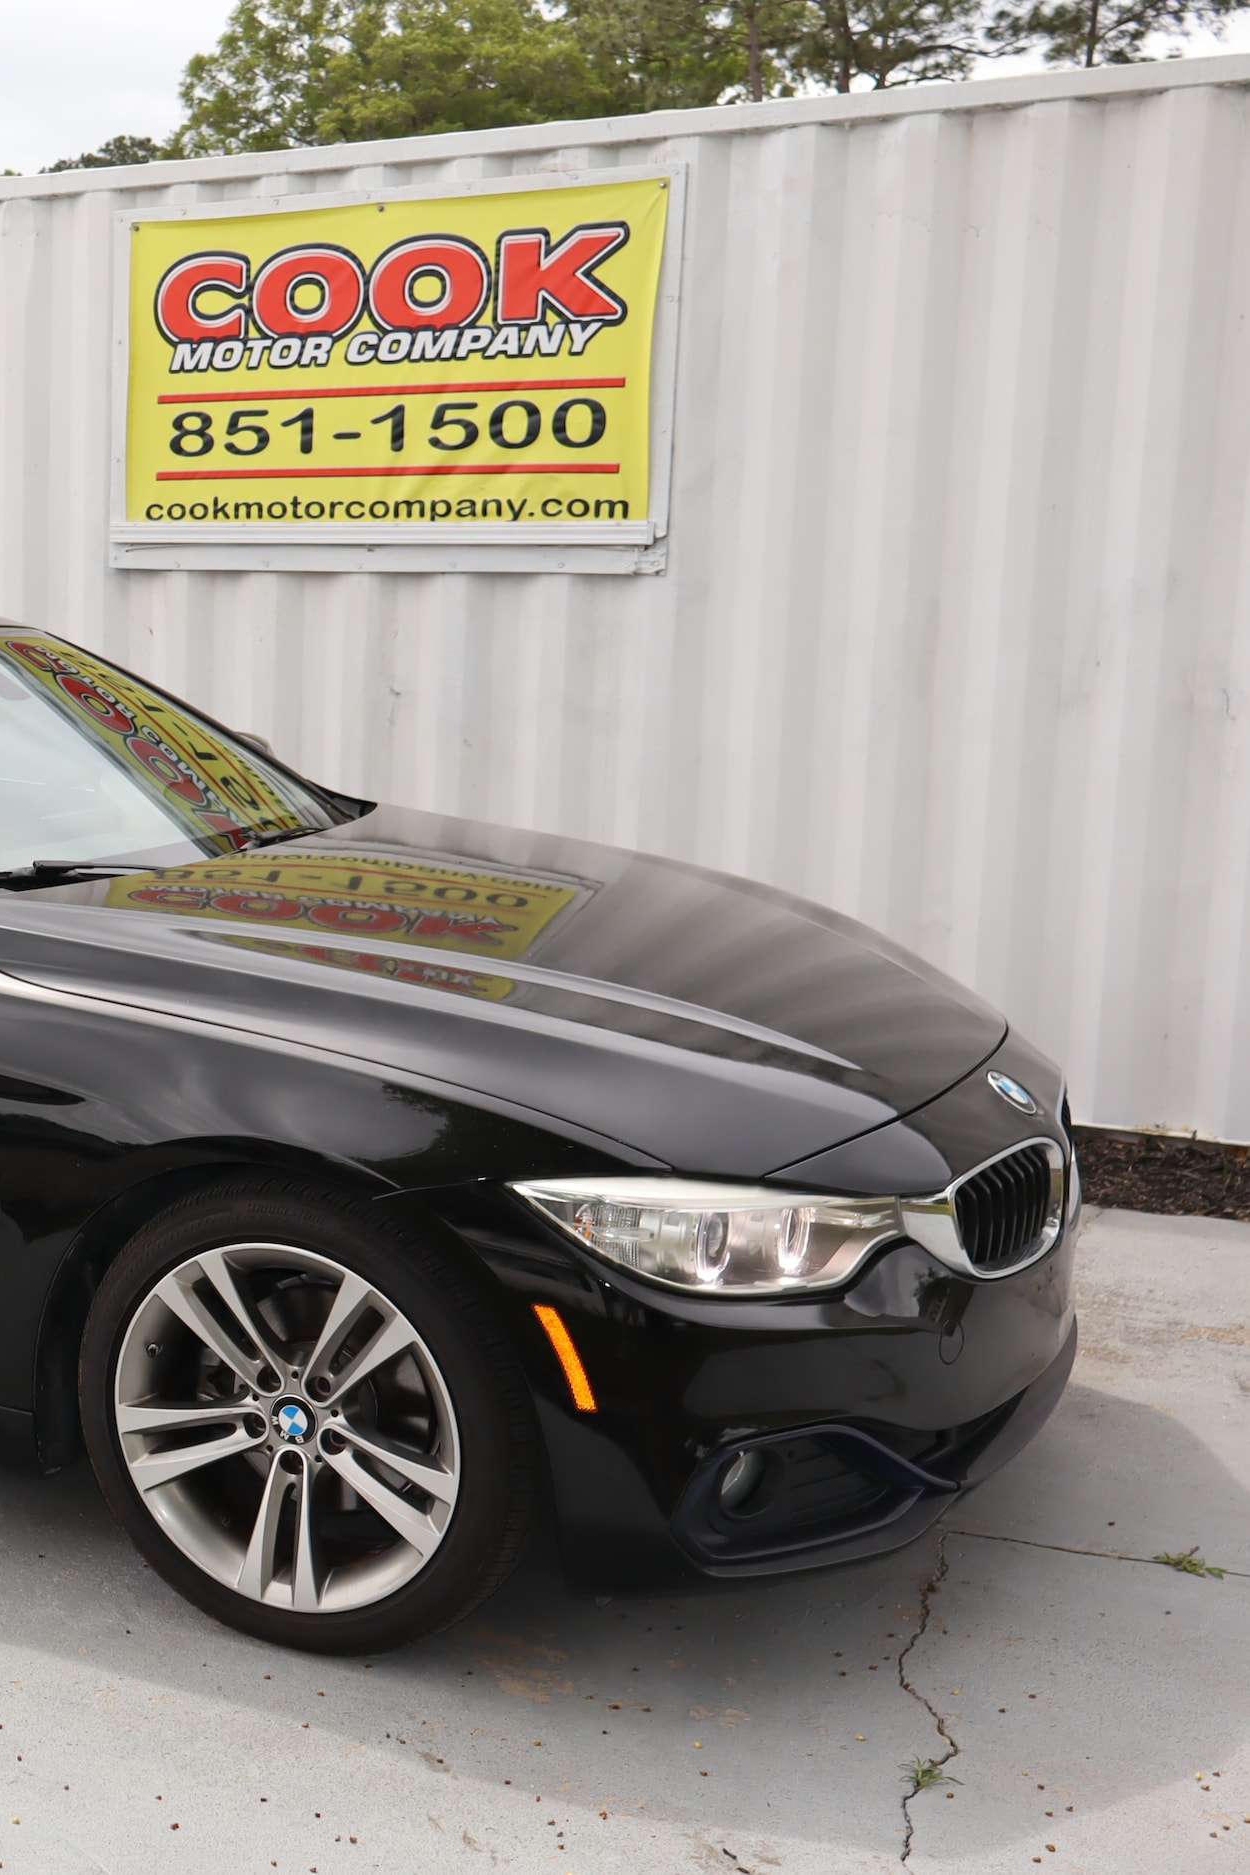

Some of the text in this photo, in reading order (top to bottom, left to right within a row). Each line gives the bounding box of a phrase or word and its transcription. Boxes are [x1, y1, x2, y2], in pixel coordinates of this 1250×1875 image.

[155, 220, 630, 344] COOK
[169, 321, 603, 373] MOTOR COMPANY
[168, 397, 607, 457] 851-1500
[145, 495, 630, 522] cookmotorcompany.com
[271, 1415, 305, 1444] BMW
